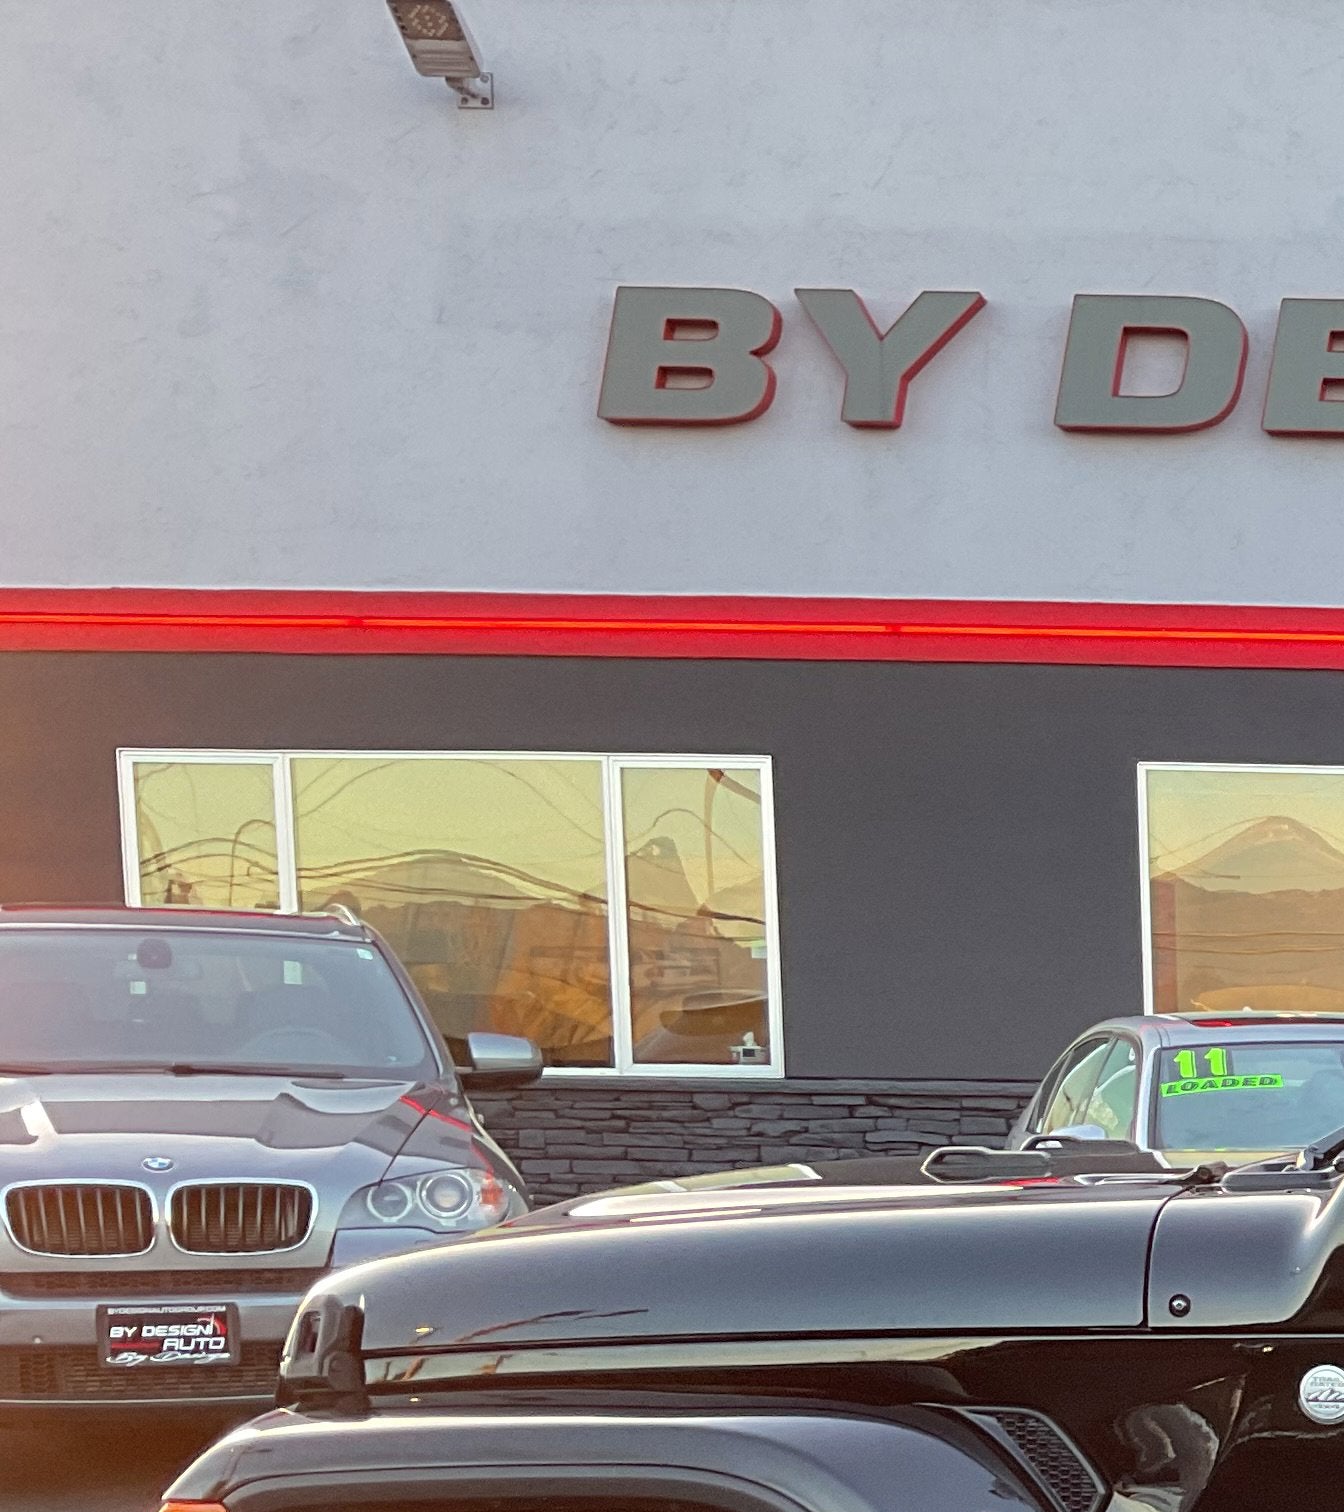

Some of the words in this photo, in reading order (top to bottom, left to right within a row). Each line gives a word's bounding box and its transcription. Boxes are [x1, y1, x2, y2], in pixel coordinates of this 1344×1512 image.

[597, 284, 988, 430] BY
[1173, 1047, 1227, 1078] 11
[1166, 1076, 1278, 1095] LOADED
[109, 1326, 138, 1338] BY
[141, 1324, 213, 1338] DESIGN
[162, 1336, 226, 1352] AUTO
